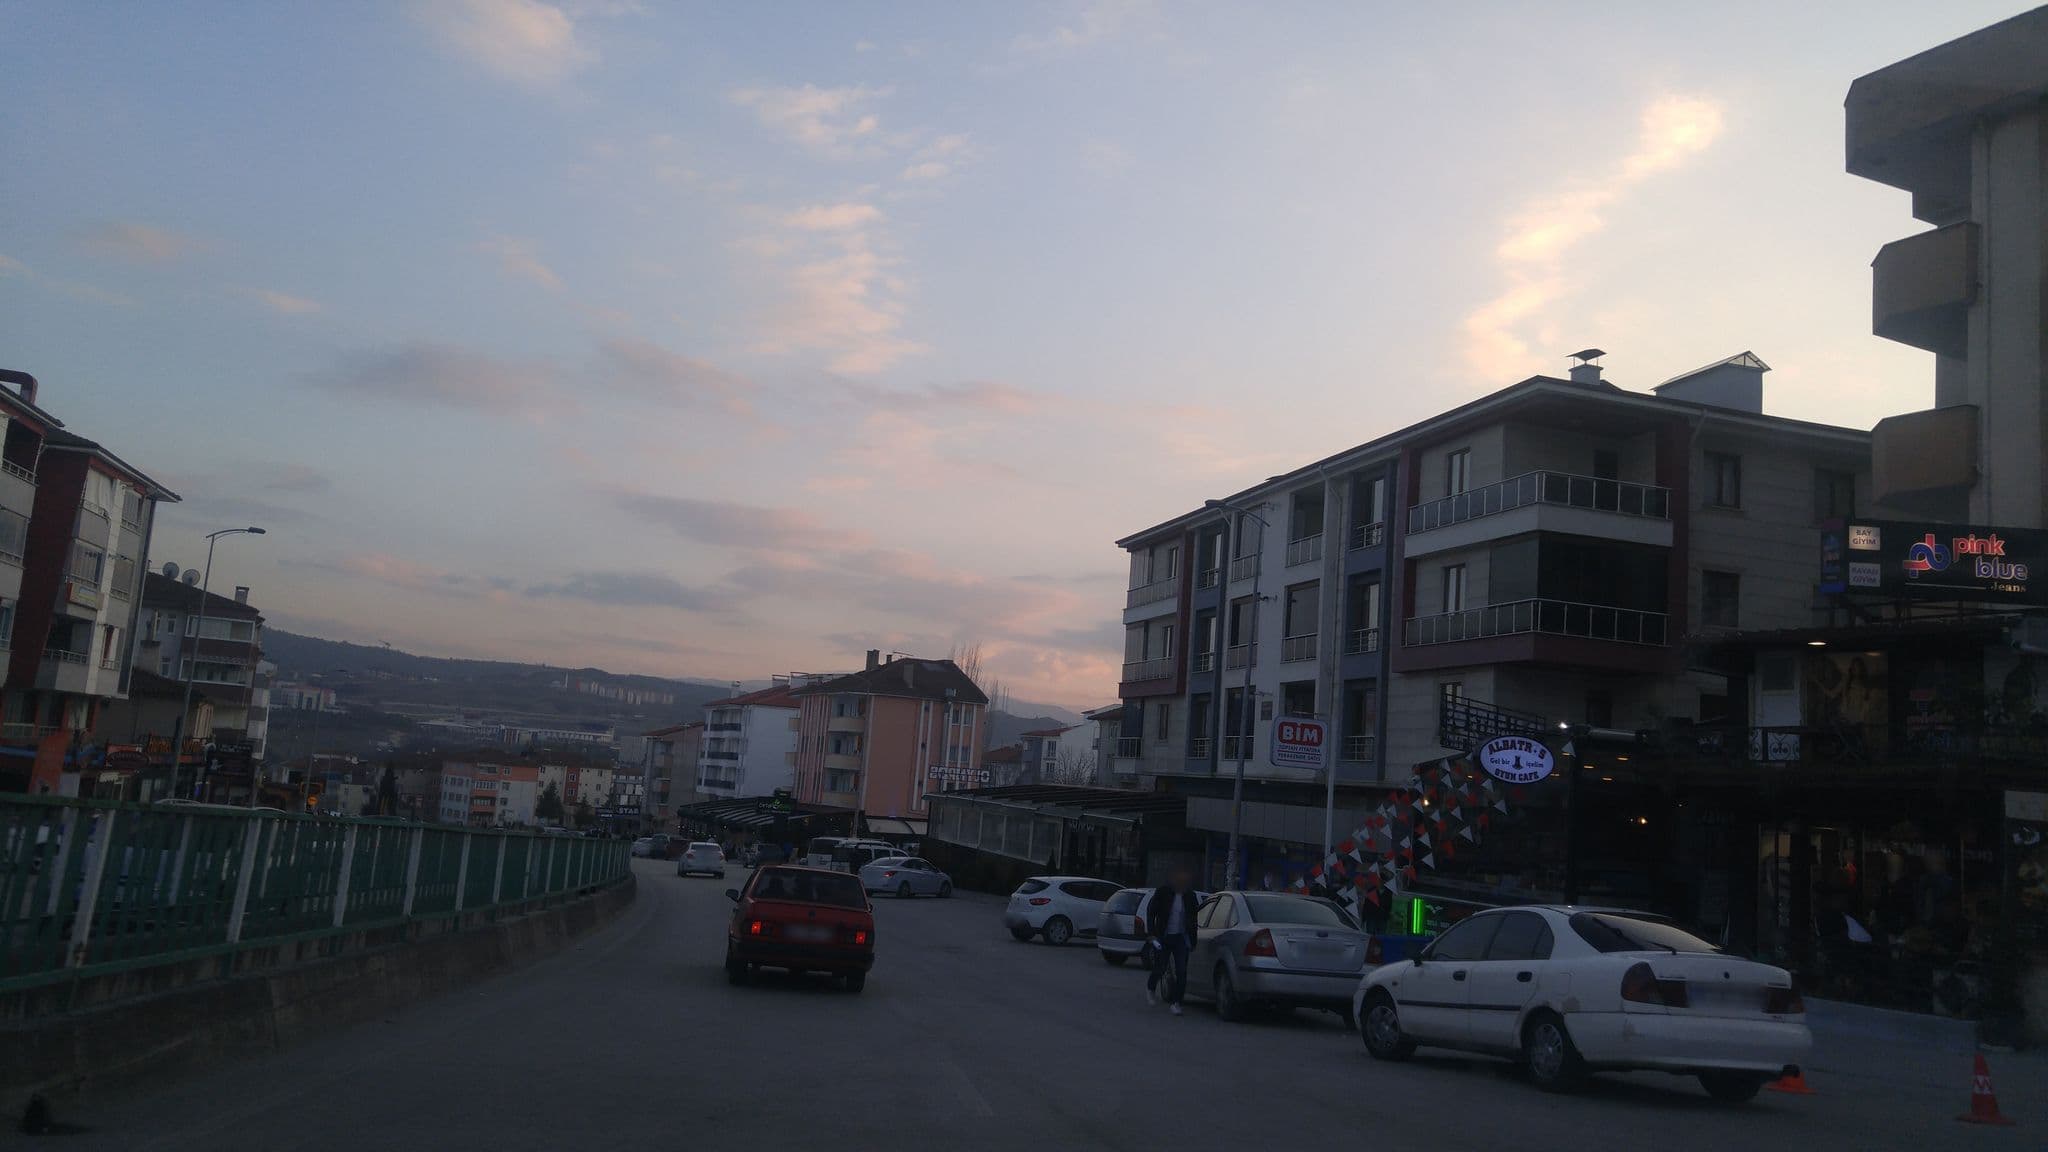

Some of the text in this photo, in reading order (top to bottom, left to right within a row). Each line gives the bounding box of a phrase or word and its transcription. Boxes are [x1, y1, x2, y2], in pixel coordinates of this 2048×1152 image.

[1953, 533, 2006, 563] pink
[1975, 556, 2029, 581] blue
[1991, 582, 2027, 592] Jeans
